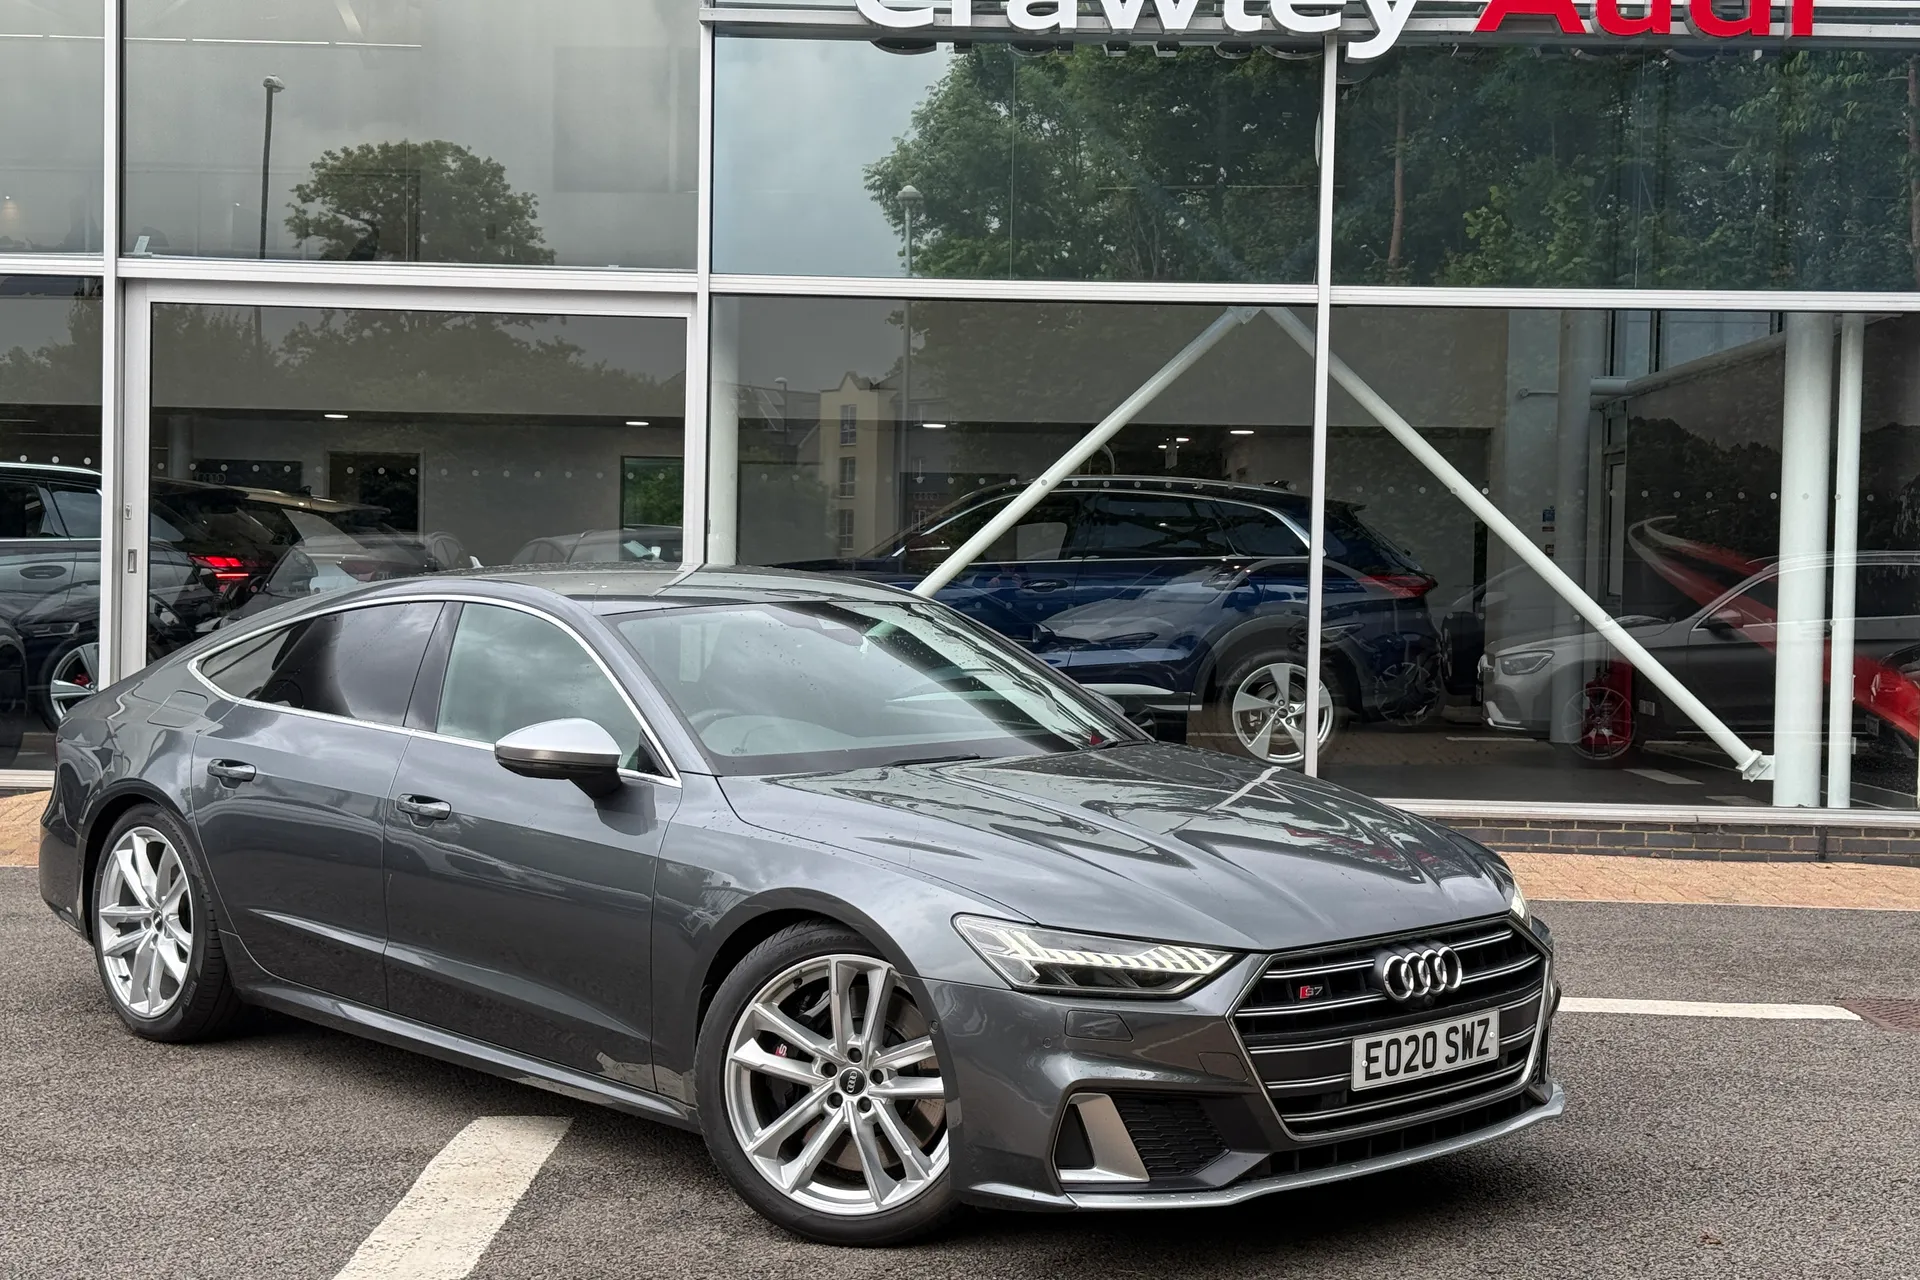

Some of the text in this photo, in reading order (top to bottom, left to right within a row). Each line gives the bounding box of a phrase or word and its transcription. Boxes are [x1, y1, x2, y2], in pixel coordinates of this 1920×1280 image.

[1303, 985, 1323, 997] S7
[1365, 1018, 1490, 1081] EO20 SWZ
